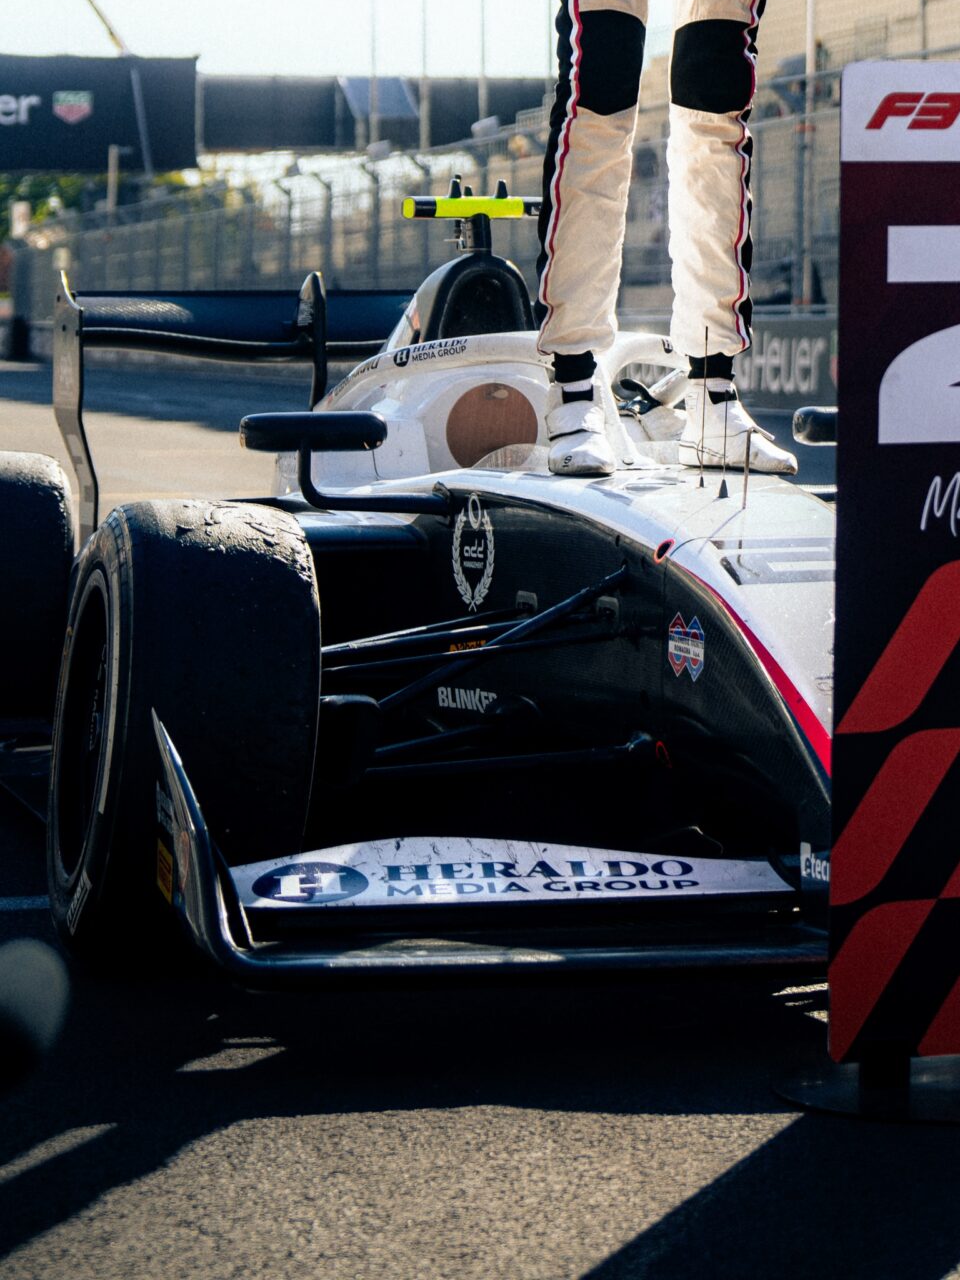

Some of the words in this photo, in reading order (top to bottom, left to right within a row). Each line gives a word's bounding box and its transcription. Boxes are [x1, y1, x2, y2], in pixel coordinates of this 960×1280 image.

[412, 351, 437, 362] MEDIA
[438, 345, 467, 358] GROUP
[382, 859, 694, 881] HERALDO
[273, 872, 348, 897] H
[387, 881, 529, 897] MEDIA
[543, 879, 700, 893] GROUP
